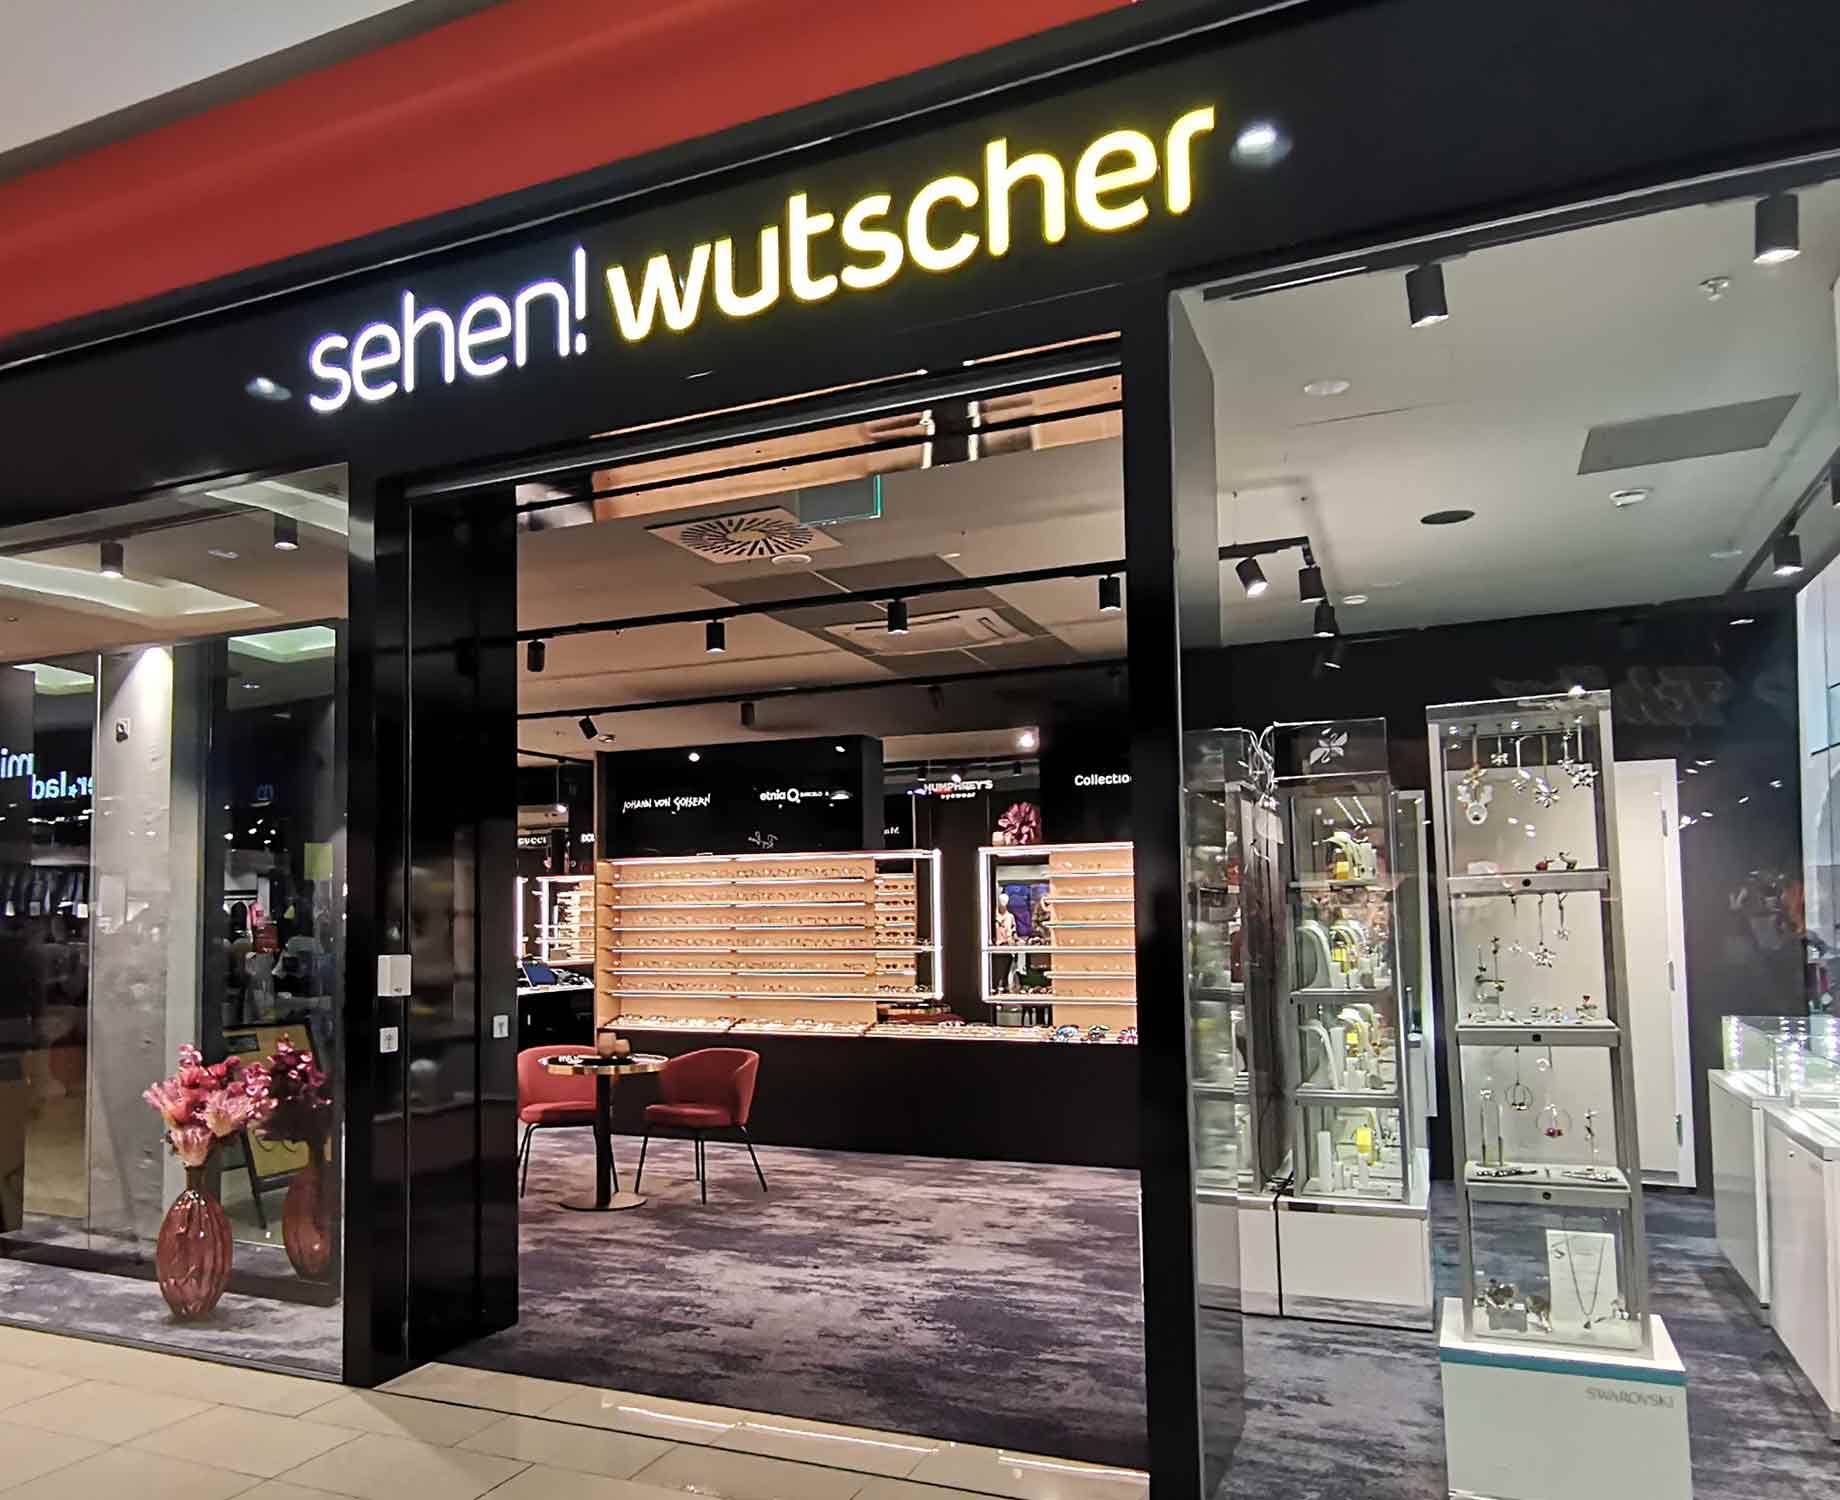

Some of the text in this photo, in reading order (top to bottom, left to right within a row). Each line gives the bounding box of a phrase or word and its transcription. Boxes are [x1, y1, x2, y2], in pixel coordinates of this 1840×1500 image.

[310, 106, 1215, 412] sehen! wutscher
[1074, 773, 1131, 786] Collectio
